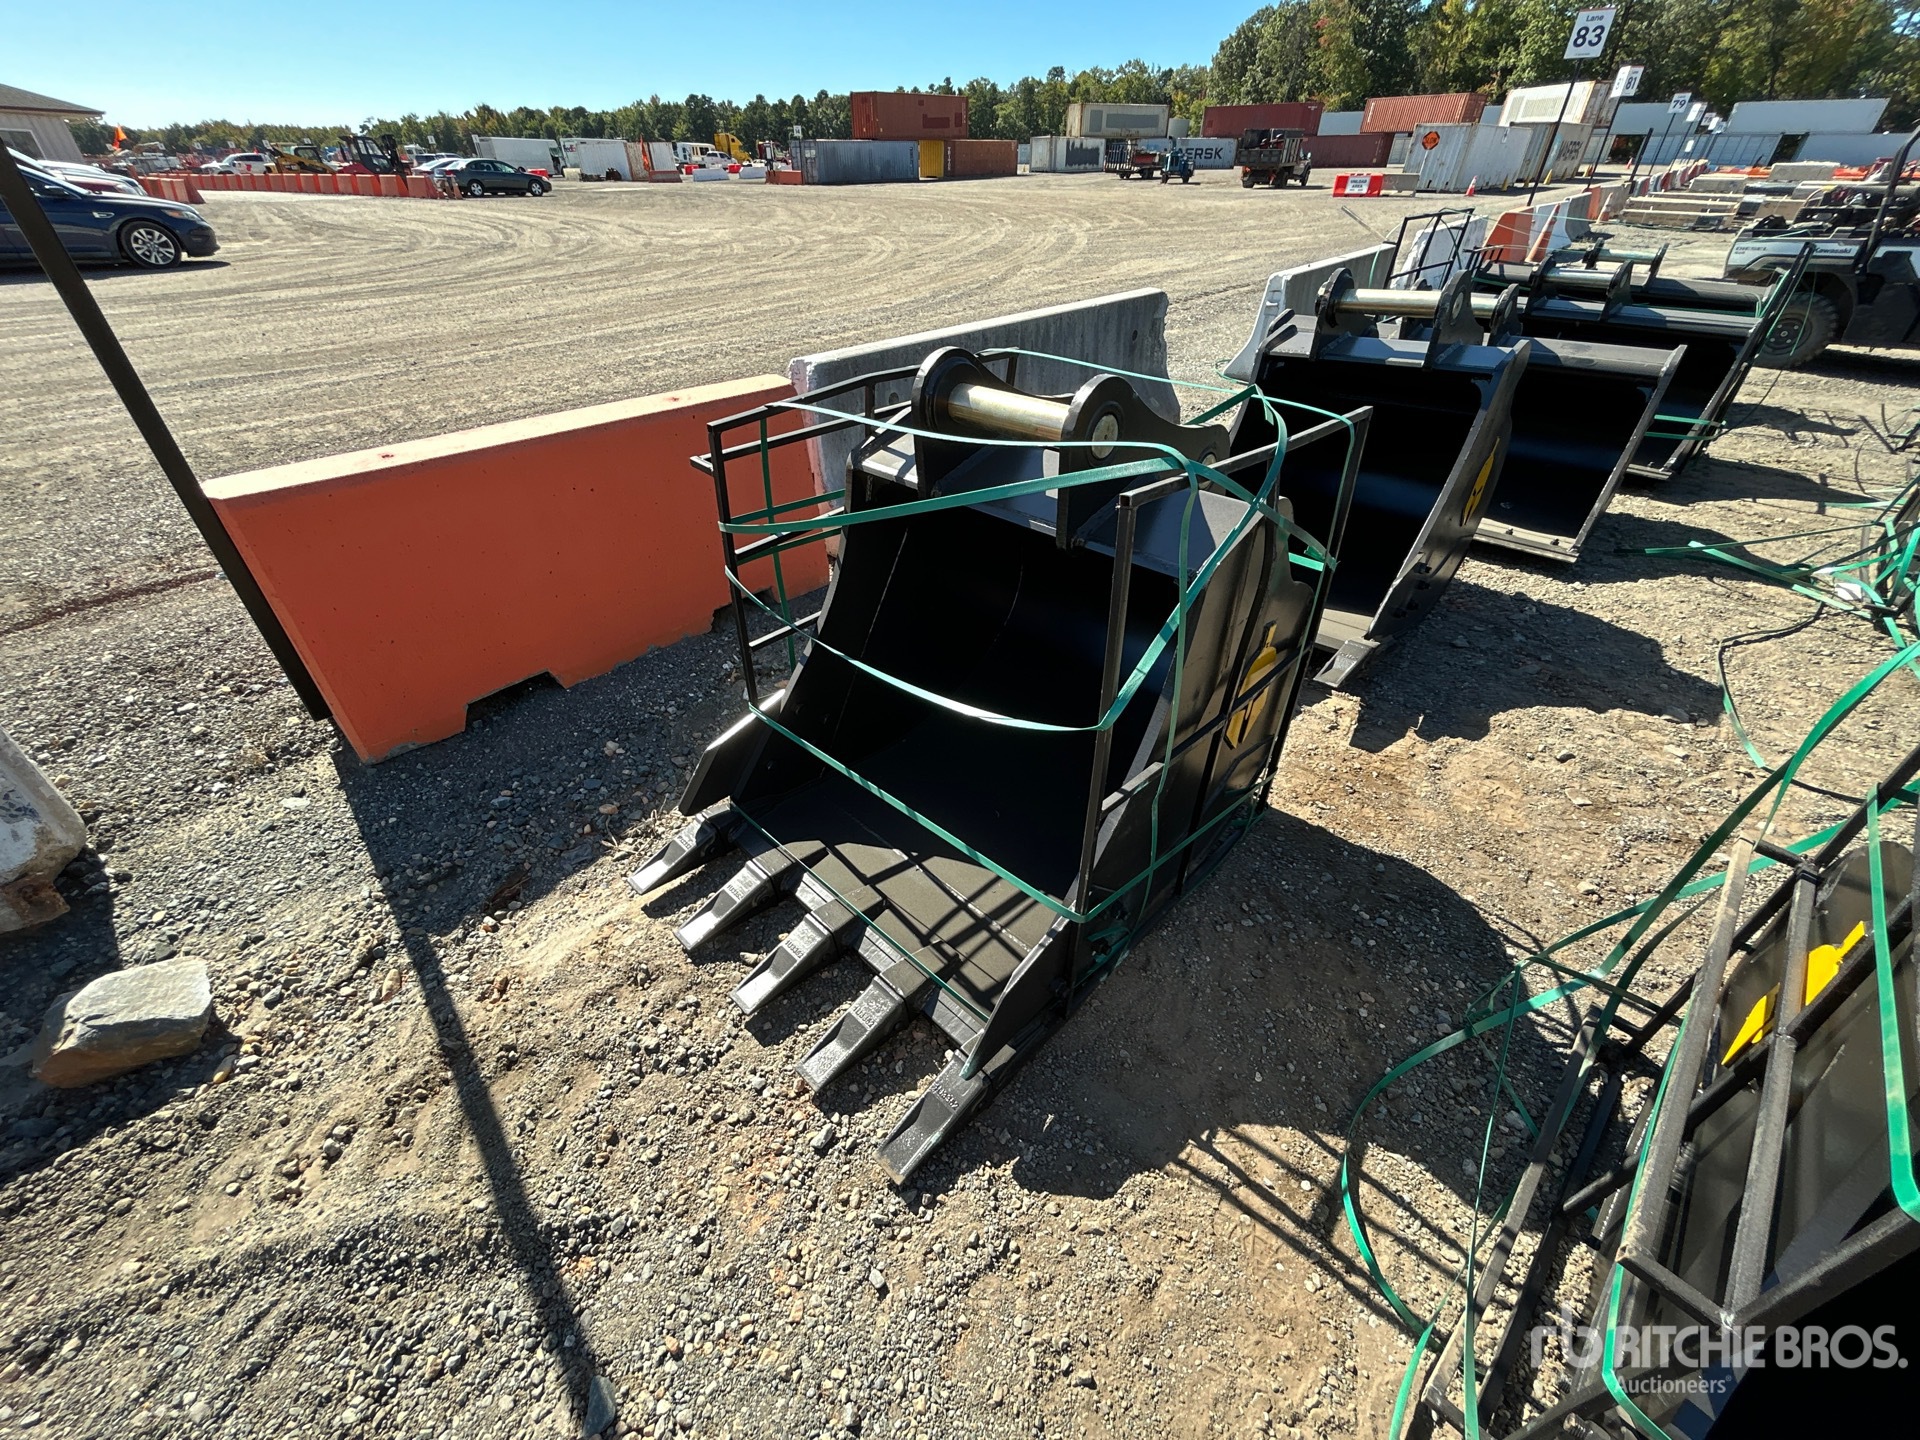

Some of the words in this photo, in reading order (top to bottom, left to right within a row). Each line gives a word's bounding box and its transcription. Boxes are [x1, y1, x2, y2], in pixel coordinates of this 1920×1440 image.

[1573, 25, 1606, 48] 83
[1625, 76, 1638, 90] 81
[1672, 99, 1686, 109] 79
